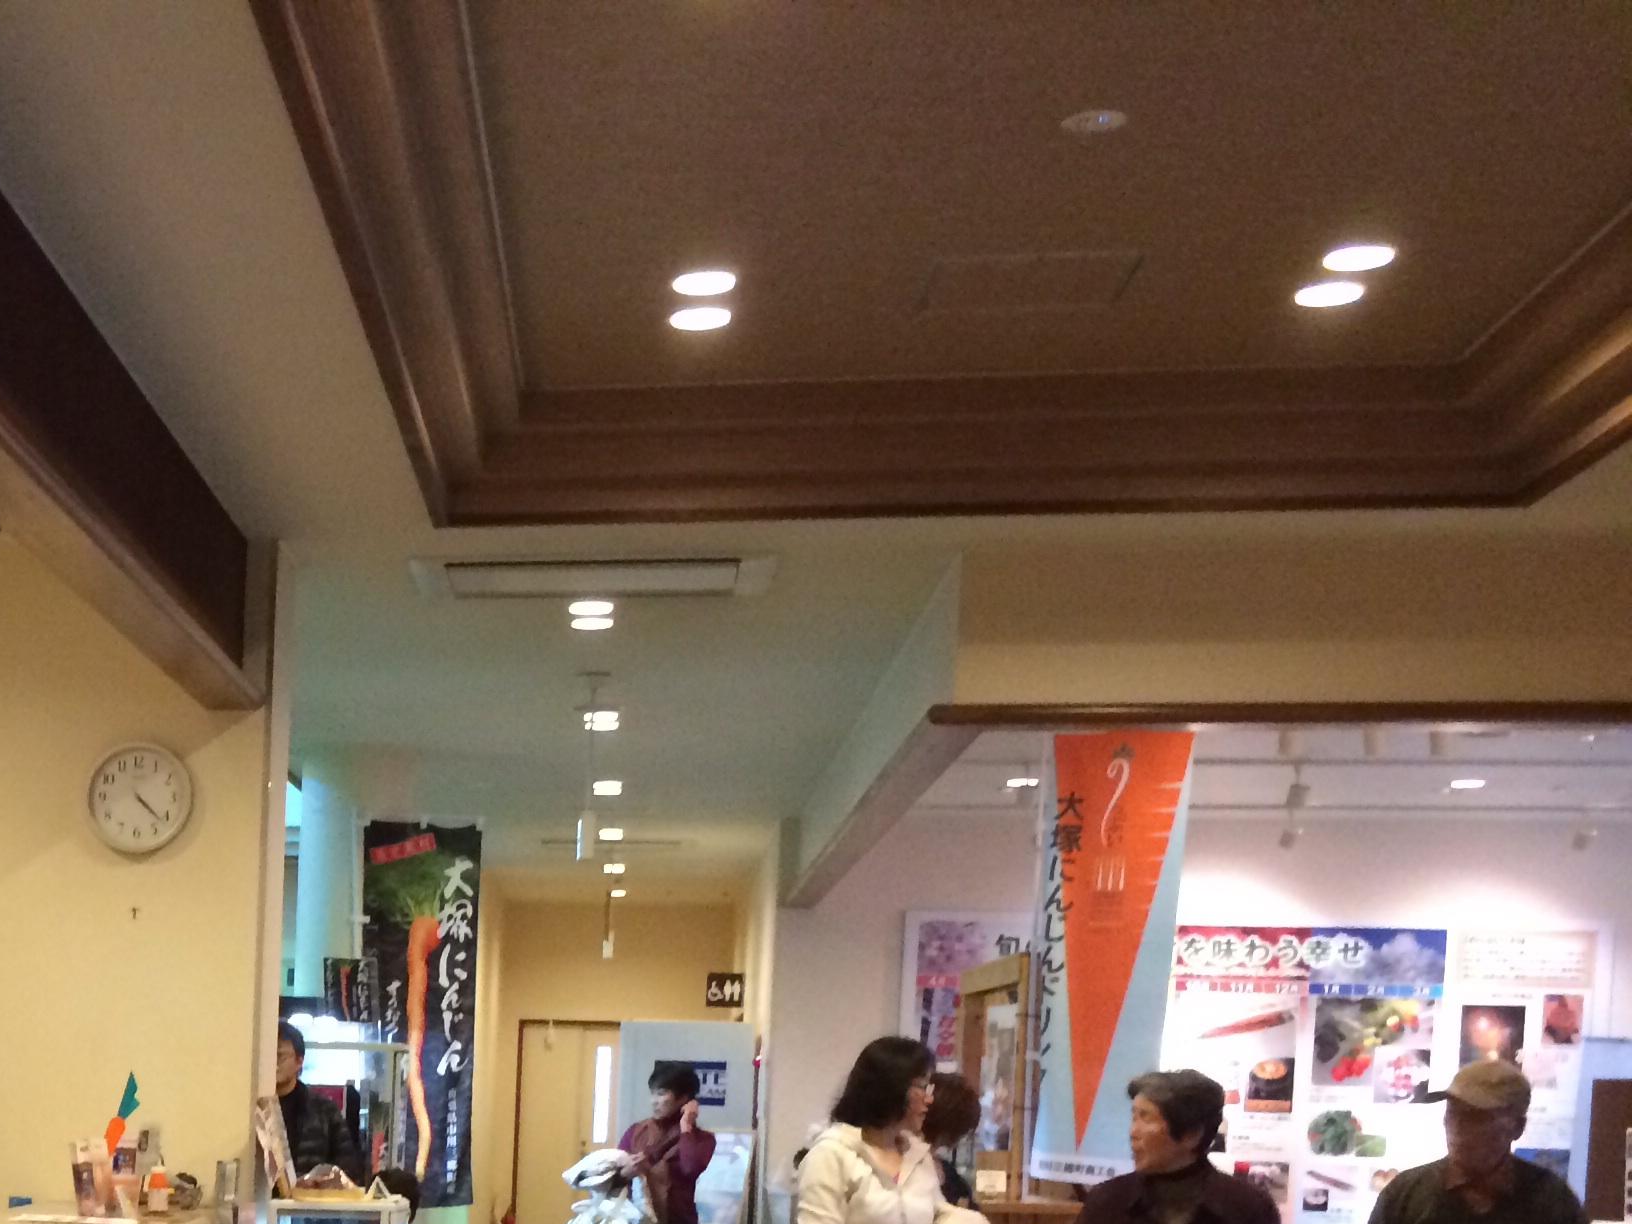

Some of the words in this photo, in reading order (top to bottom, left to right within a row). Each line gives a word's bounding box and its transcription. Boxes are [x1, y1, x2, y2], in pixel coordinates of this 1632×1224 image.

[435, 856, 474, 1077] 大塚にんじん
